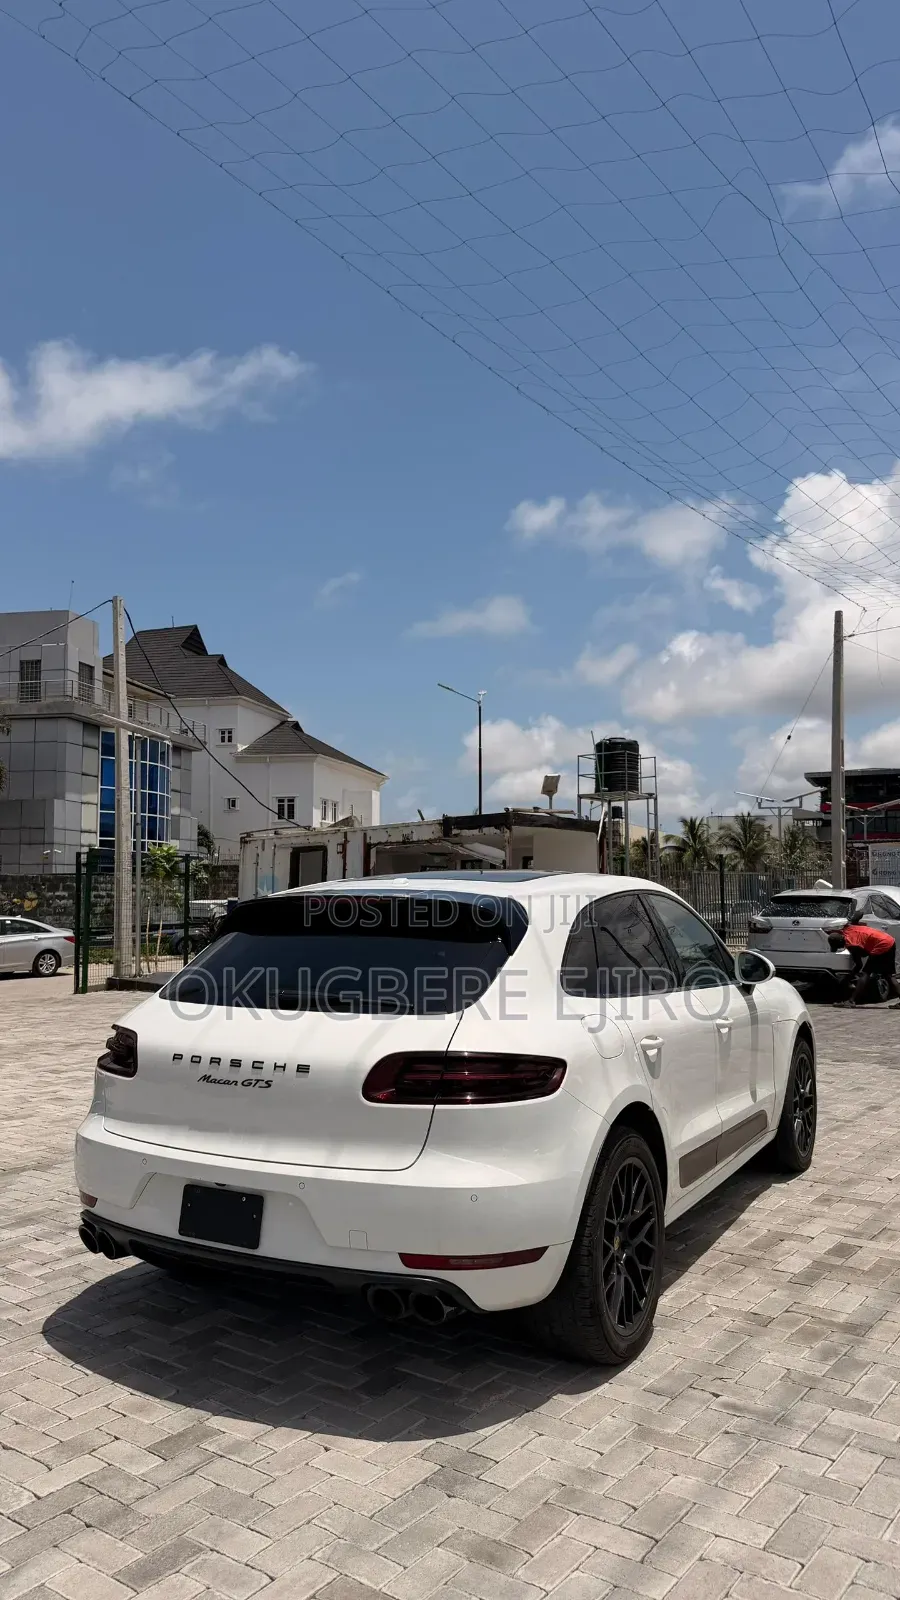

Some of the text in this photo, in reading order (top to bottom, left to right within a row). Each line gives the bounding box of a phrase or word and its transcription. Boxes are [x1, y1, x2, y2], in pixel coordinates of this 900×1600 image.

[172, 1053, 310, 1073] PORSCHE
[197, 1074, 274, 1089] Macan GTS
